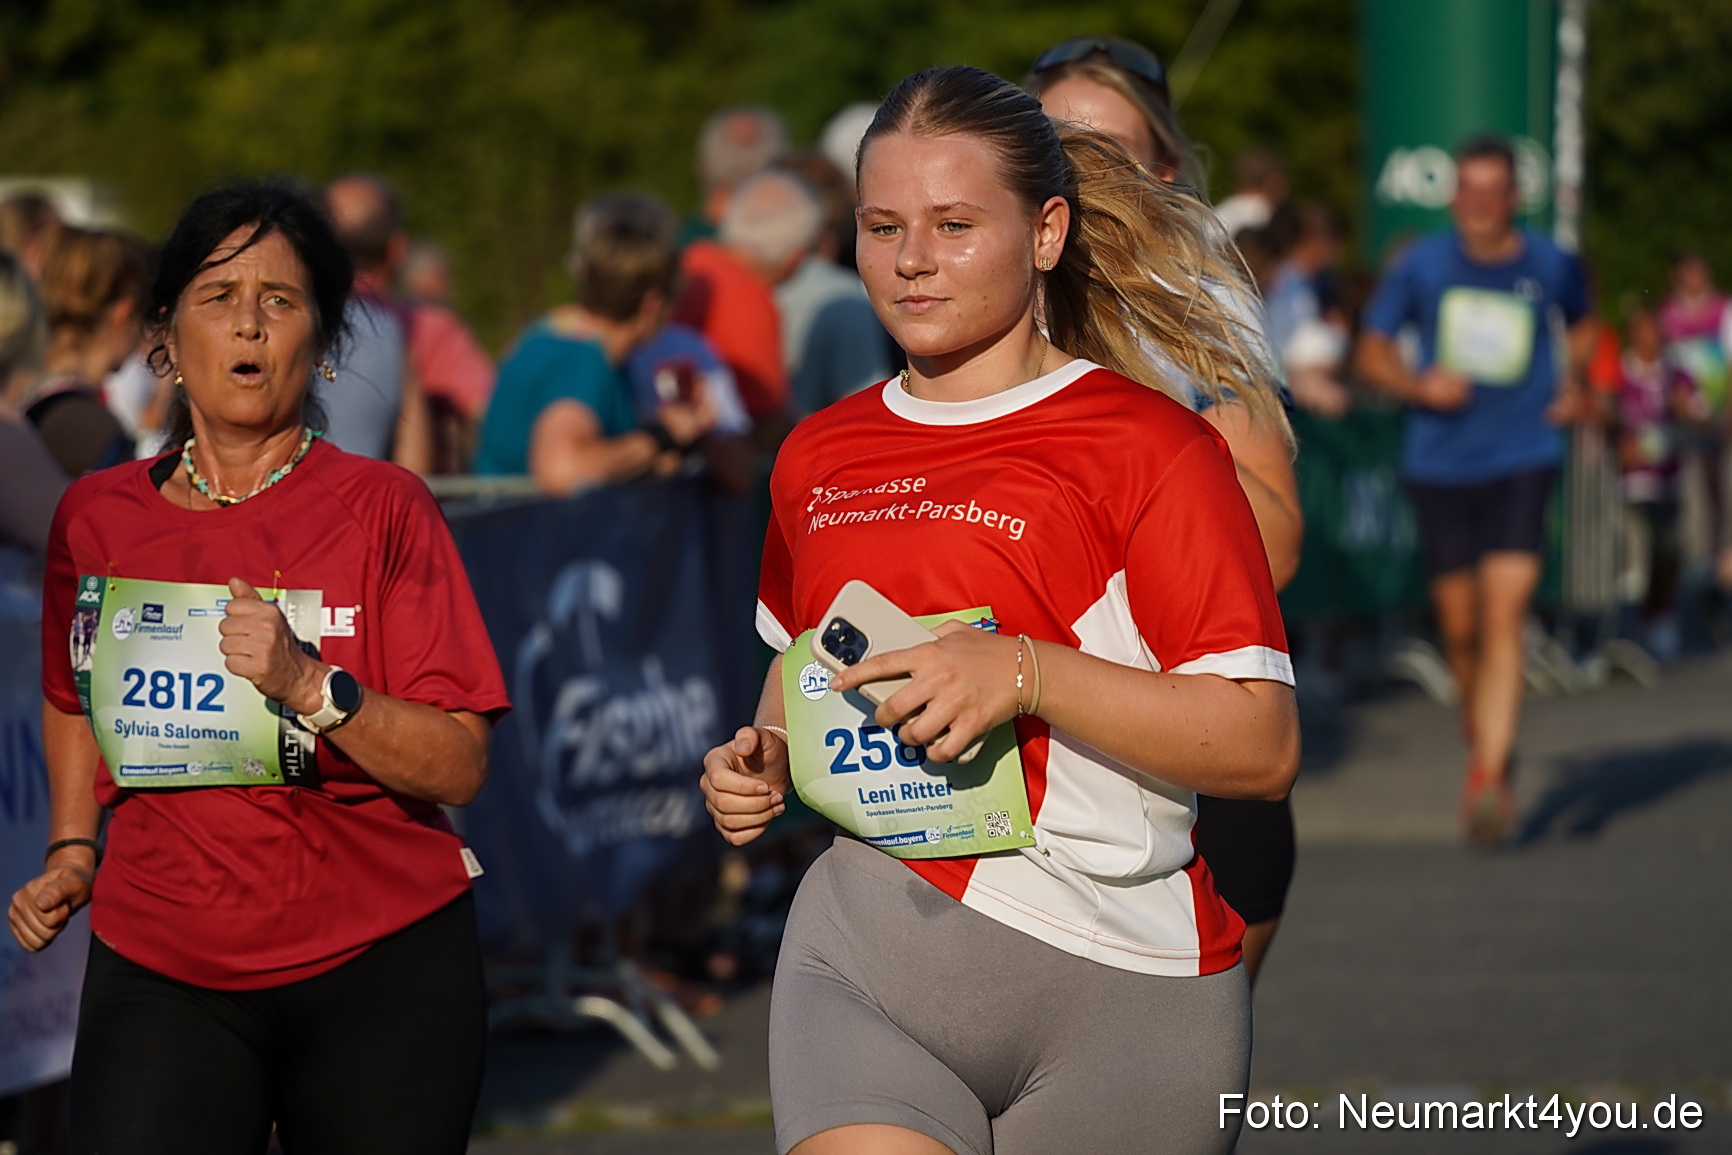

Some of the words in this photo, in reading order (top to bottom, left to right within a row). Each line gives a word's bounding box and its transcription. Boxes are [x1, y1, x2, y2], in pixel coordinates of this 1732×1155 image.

[807, 500, 1026, 541] Neumarkt-Parsberg
[79, 590, 101, 603] AOK
[122, 667, 225, 712] 2812
[114, 718, 160, 738] Sylvia
[164, 722, 240, 741] Salomon
[825, 722, 928, 775] 258
[858, 784, 896, 804] Leni
[900, 781, 953, 801] Ritter
[865, 809, 895, 818] Sparkasse
[895, 803, 953, 814] Neumarkt-Parsberg
[942, 828, 975, 839] Firmenlauf
